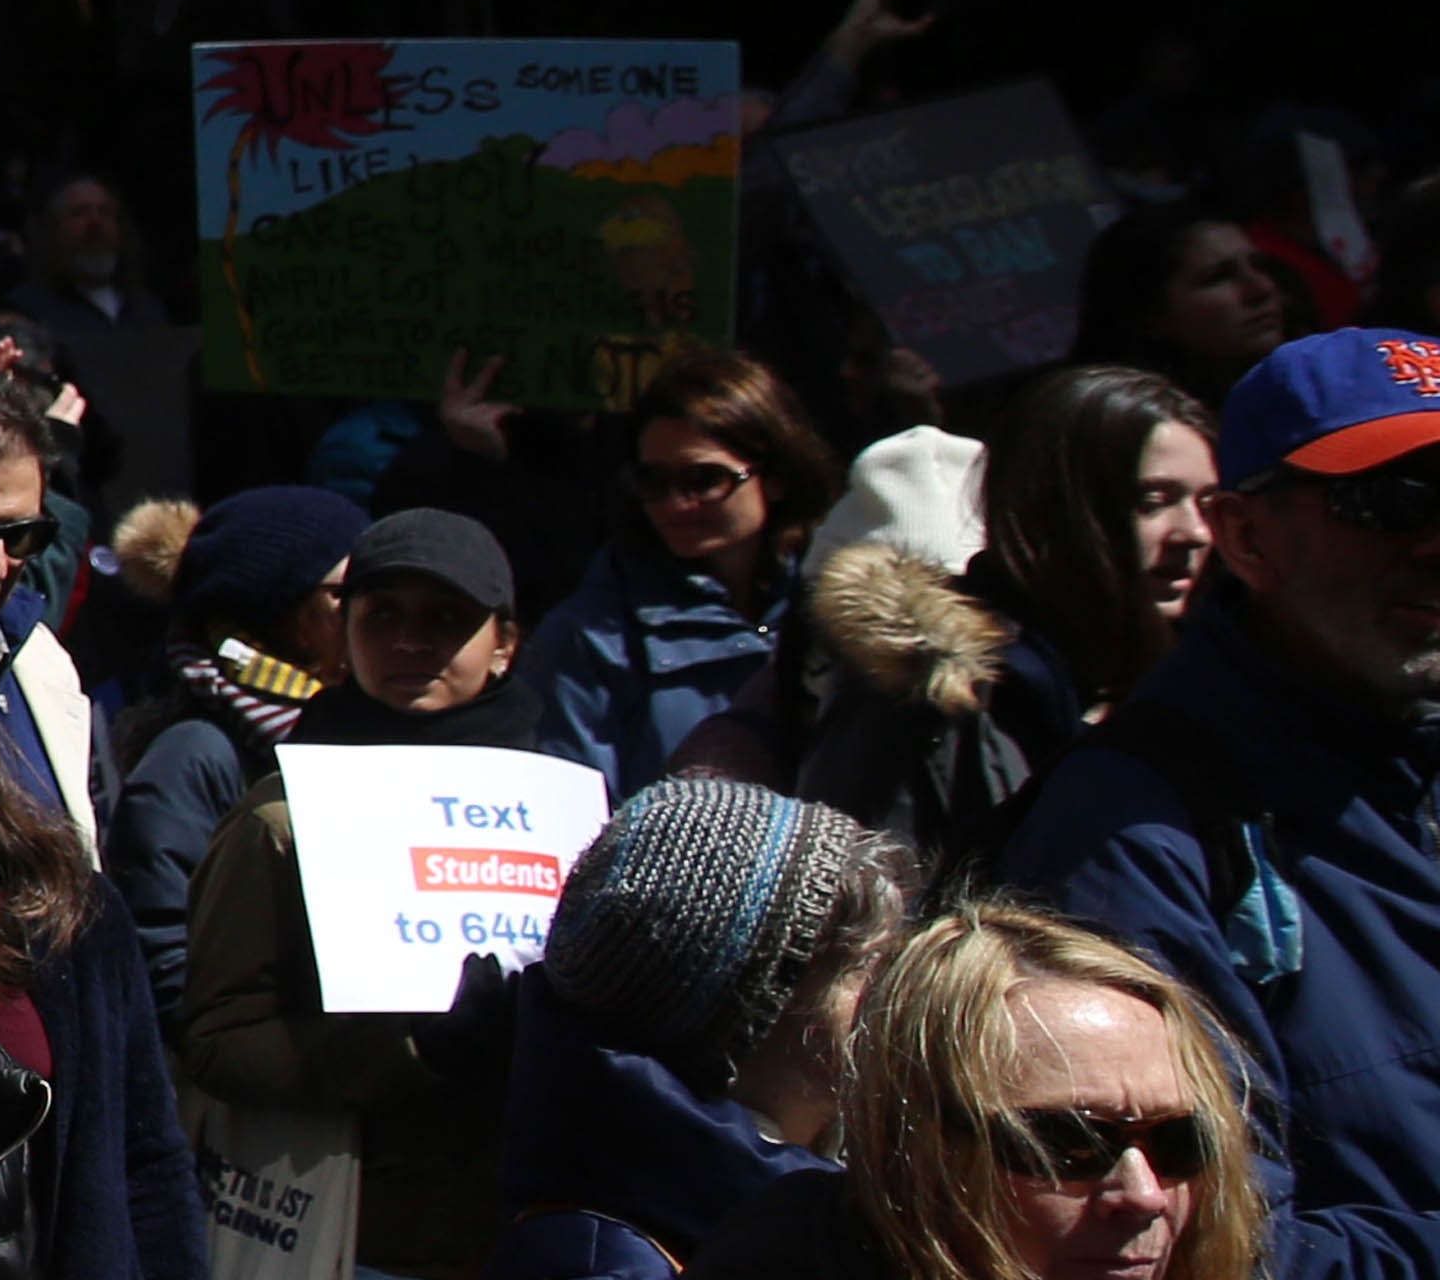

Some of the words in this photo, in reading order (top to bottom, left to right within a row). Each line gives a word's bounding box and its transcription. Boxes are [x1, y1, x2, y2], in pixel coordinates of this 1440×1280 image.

[244, 49, 501, 131] UNLESS
[291, 148, 391, 195] LIKE
[407, 142, 548, 234] YOU
[249, 213, 407, 264] CARES
[438, 239, 463, 269] A
[431, 797, 532, 832] Text
[425, 856, 557, 890] Students
[394, 913, 443, 946] to
